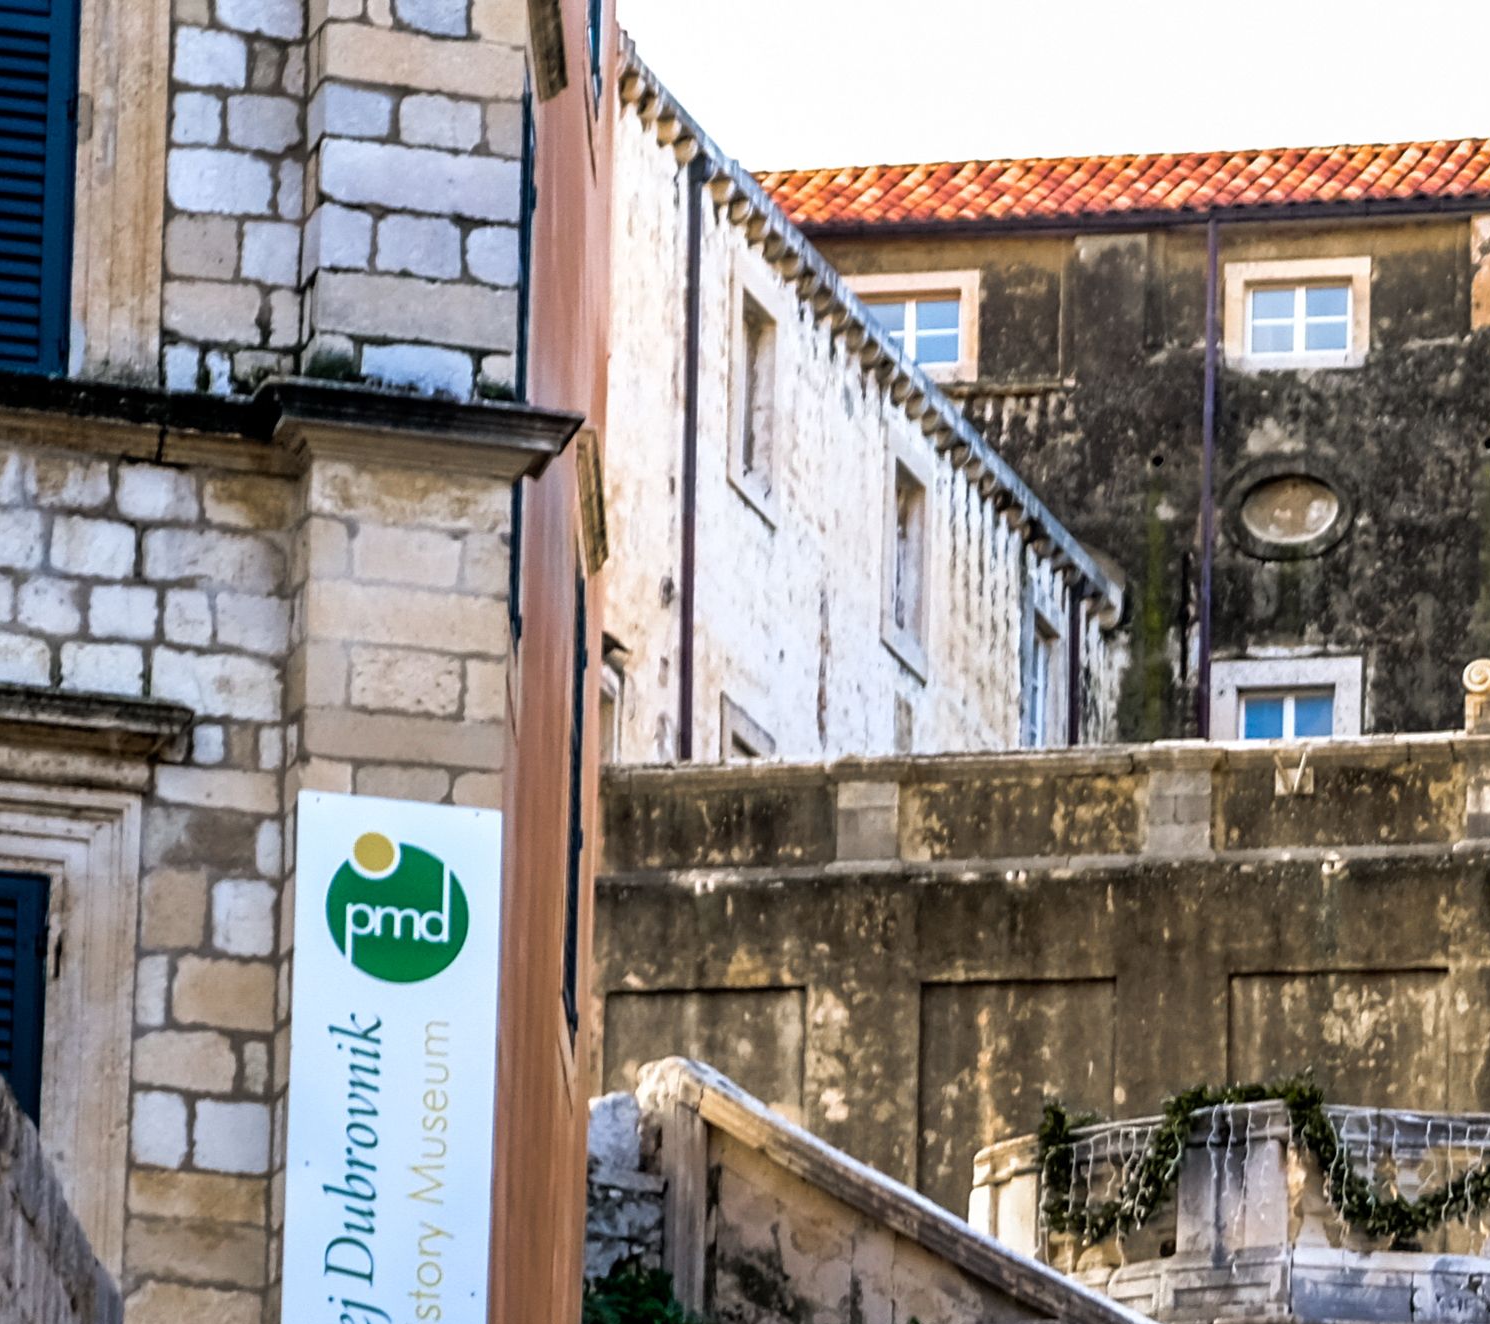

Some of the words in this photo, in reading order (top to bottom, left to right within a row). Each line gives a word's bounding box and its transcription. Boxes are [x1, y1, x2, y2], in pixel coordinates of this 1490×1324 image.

[344, 866, 454, 968] pmd
[322, 1012, 383, 1286] Dubrovnik
[406, 1018, 451, 1204] Museum
